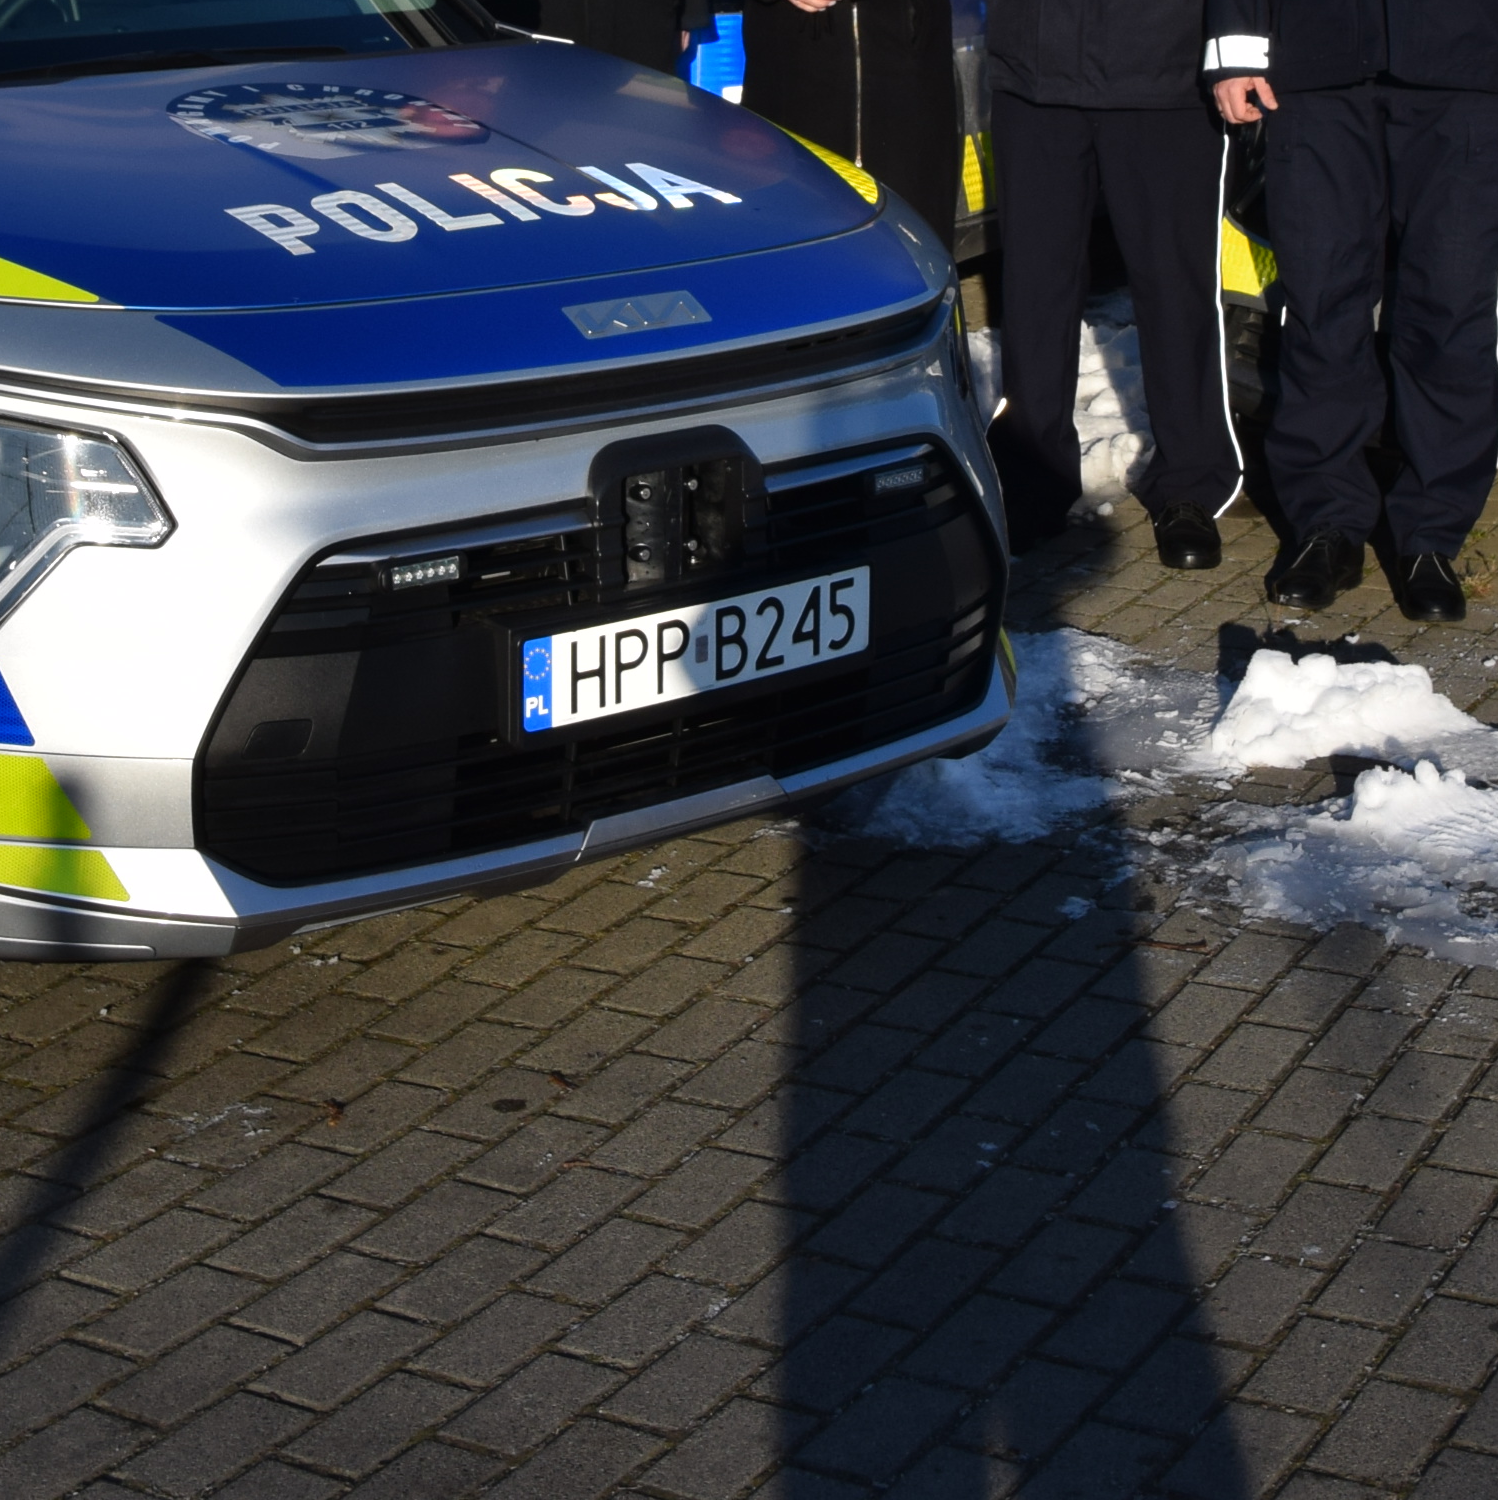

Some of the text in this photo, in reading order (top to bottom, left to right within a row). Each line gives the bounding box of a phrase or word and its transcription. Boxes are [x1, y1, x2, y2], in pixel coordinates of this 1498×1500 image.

[327, 119, 370, 132] 112
[223, 162, 743, 257] POLICJA
[570, 576, 856, 715] HPP B245
[525, 694, 550, 718] PL
